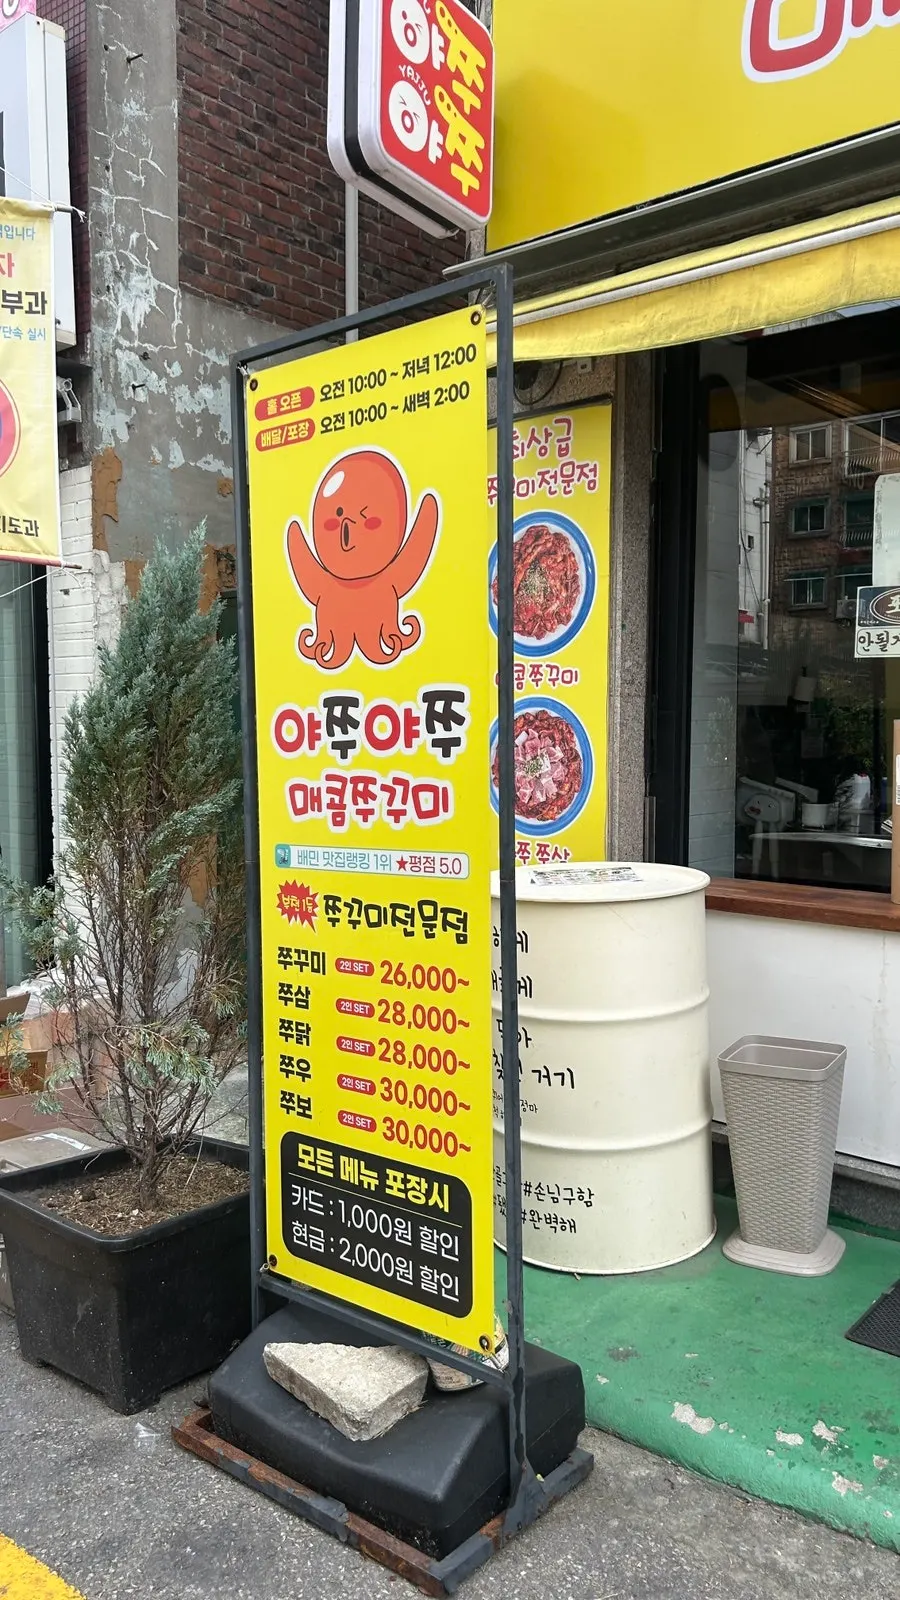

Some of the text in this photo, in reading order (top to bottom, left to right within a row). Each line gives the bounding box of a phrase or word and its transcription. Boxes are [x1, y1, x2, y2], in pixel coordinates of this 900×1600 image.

[1, 289, 48, 315] 부과
[28, 327, 46, 341] 실시
[266, 399, 278, 416] 홀
[279, 391, 302, 413] 오픈
[319, 379, 346, 403] 오전
[348, 368, 388, 395] 10:00
[402, 355, 431, 381] 저녁
[433, 343, 478, 372] 12:00
[260, 421, 310, 448] 배달/포장
[320, 412, 346, 435] 오전
[348, 401, 388, 428] 10:00
[402, 387, 431, 415] 새벽
[434, 380, 471, 406] 2:00
[495, 663, 579, 690] 콤쭈꾸미
[274, 690, 466, 760] 야쭈야쭈
[288, 773, 449, 827] 매콤쭈꾸미
[297, 849, 320, 867] 배민
[322, 851, 370, 870] 맛집랭킹
[373, 853, 393, 872] 1위
[439, 856, 463, 875] 5.0
[323, 894, 469, 945] 쭈꾸미전문점
[277, 946, 327, 976] 쭈꾸미
[339, 960, 352, 972] 2인
[353, 961, 370, 973] SET
[379, 959, 470, 994] 26,000~
[277, 982, 470, 1035] 쭈삼 2인 SET 28,000~
[278, 1017, 312, 1047] 쭈닭
[341, 1038, 353, 1050] 2인
[354, 1040, 371, 1053] SET
[378, 1037, 471, 1076] 28,000~
[279, 1054, 312, 1083] 쭈우
[341, 1076, 354, 1088] 2인
[354, 1078, 371, 1092] SET
[379, 1076, 471, 1117] 30,000~
[531, 1065, 575, 1089] 거기
[279, 1090, 471, 1158] 쭈보 2인 SET 30,000~
[297, 1142, 335, 1178] 모든
[339, 1154, 380, 1191] 메뉴
[385, 1168, 450, 1213] 포장시
[523, 1180, 595, 1208] #손님구함
[291, 1184, 325, 1216] 카드
[338, 1198, 412, 1246] 1,000원
[418, 1225, 460, 1262] 할인
[520, 1209, 577, 1234] #완벽해
[291, 1220, 326, 1253] 현금
[339, 1237, 414, 1286] 2,000원
[419, 1265, 460, 1302] 할인
